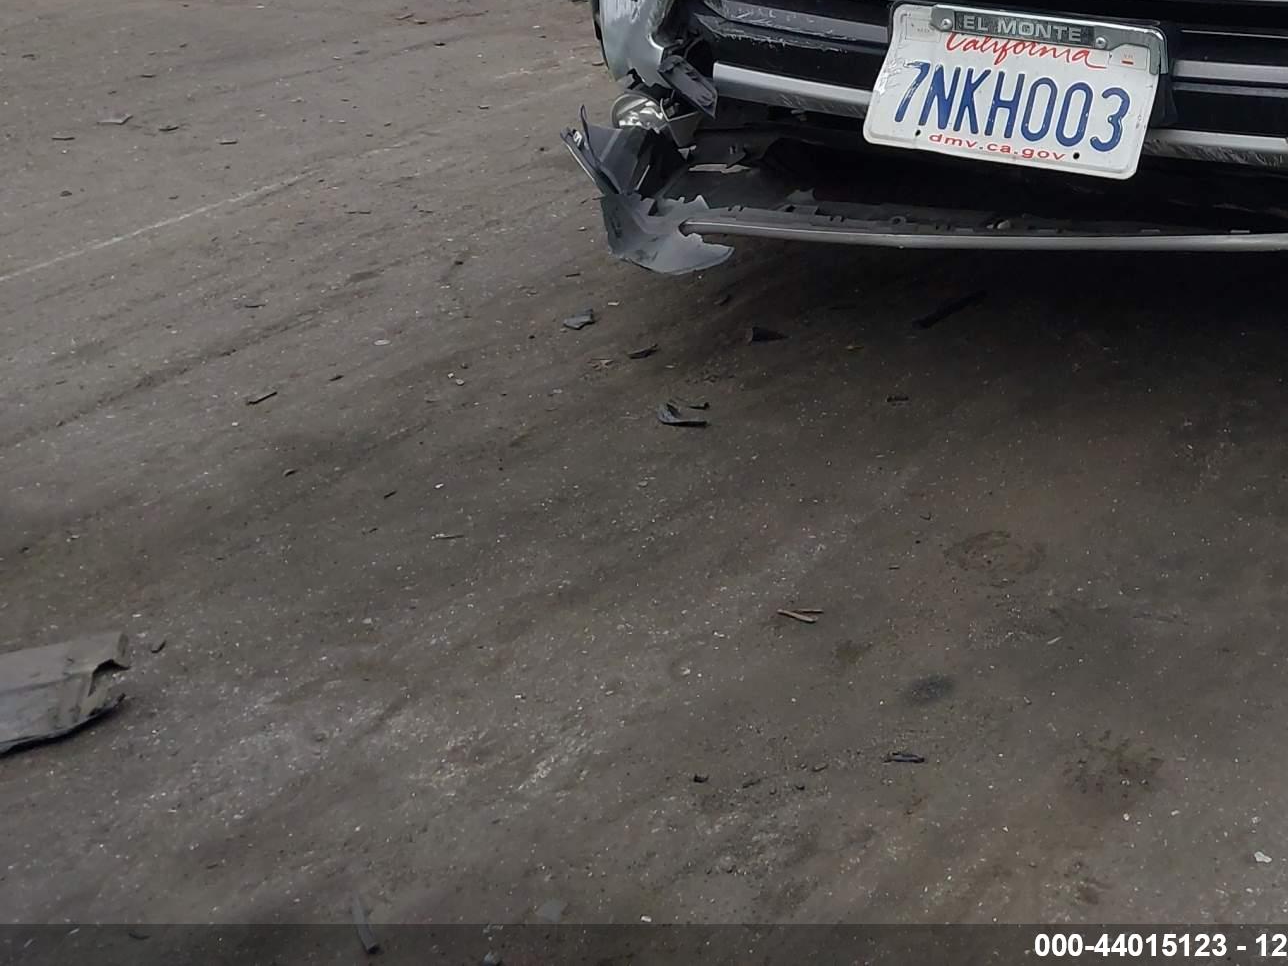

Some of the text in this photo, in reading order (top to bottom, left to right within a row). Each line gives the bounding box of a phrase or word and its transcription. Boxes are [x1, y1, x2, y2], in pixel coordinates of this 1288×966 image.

[962, 14, 1083, 42] EL MONTE
[945, 31, 1107, 69] California
[894, 60, 1131, 152] 7NKH003
[929, 133, 1066, 161] dmv.ca.gov
